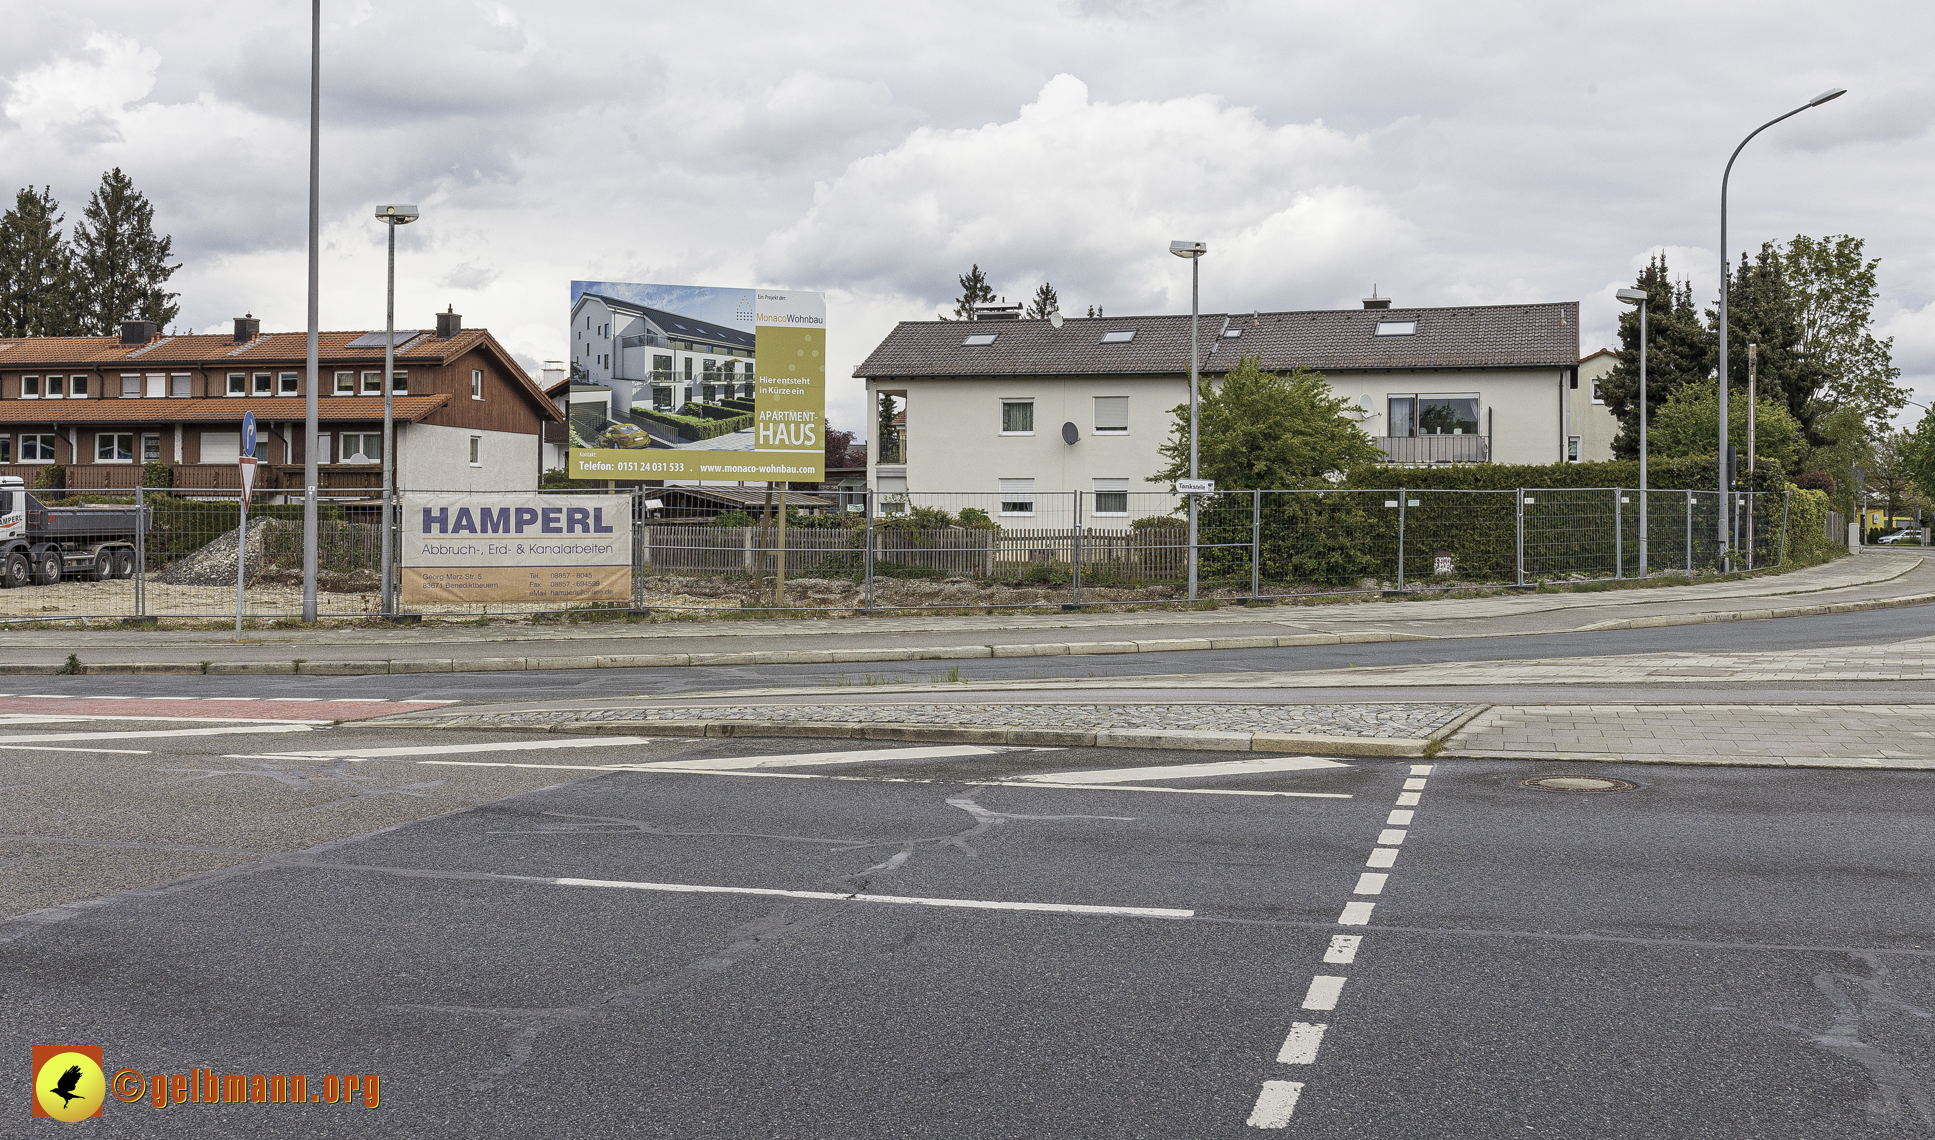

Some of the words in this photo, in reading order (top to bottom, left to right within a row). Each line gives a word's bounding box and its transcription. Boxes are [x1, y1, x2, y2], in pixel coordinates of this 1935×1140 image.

[764, 294, 779, 302] Projekt
[756, 312, 824, 325] MonacoWohnbau
[759, 376, 776, 384] Hier
[776, 376, 811, 385] entsteht
[759, 386, 767, 394] in
[768, 386, 791, 395] Kürze
[791, 387, 805, 395] ein
[759, 410, 818, 422] APARTMENT-
[759, 422, 816, 446] HAUS
[579, 460, 615, 471] Telefon:
[617, 461, 638, 471] 0151
[640, 462, 651, 472] 24
[652, 462, 667, 472] 031
[669, 462, 685, 472] 533
[700, 463, 816, 474] www.monaco-wohnbau.com
[422, 507, 614, 534] HAMPERL
[421, 543, 484, 556] Abbruch-,
[488, 543, 512, 555] Erd-
[516, 543, 525, 555] &
[529, 543, 613, 555] Kanalarbeiten
[422, 573, 476, 582] Georg-Merz-Str.
[529, 572, 541, 580] Tel.
[529, 589, 547, 597] eMail
